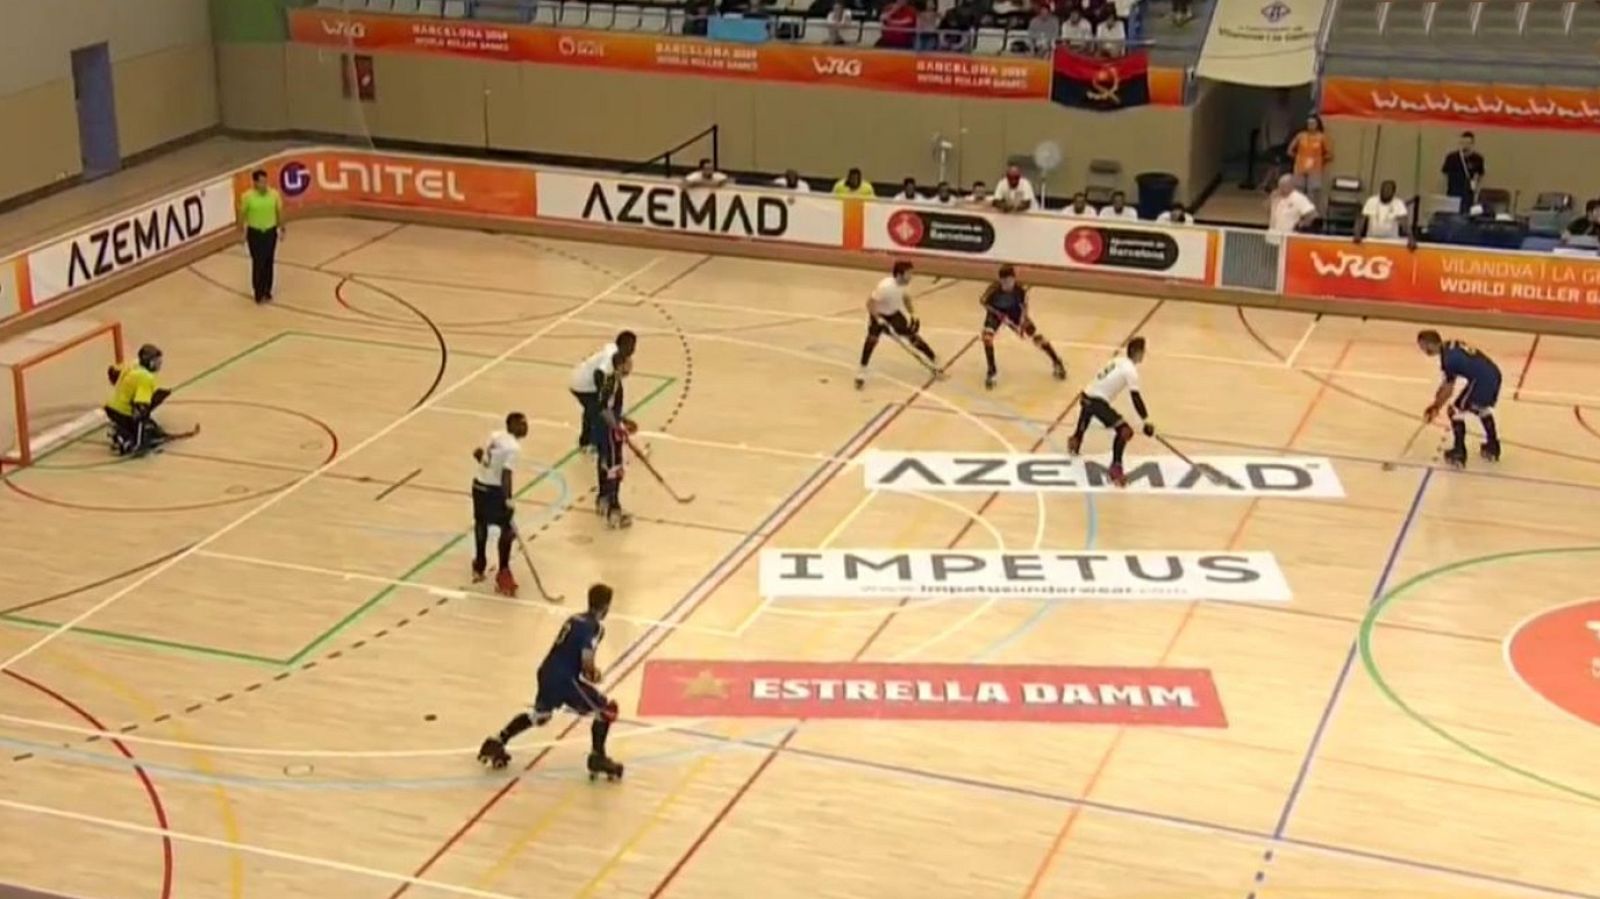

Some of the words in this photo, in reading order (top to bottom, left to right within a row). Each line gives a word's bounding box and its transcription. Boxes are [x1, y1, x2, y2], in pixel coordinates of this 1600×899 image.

[916, 60, 997, 76] BARCELONA
[316, 160, 466, 201] UNITEL
[581, 181, 789, 236] AZEMAD
[67, 194, 205, 287] AZEMAD
[929, 229, 983, 244] Barcelona
[1109, 246, 1165, 260] Barcelona
[1310, 250, 1394, 281] WRG
[1441, 256, 1533, 279] VILANOVA
[1552, 266, 1576, 283] LA
[1440, 276, 1505, 297] WORLD
[1511, 283, 1580, 304] ROLLER
[878, 457, 1315, 491] AZEMAD
[779, 552, 1262, 584] IMPETUS
[751, 677, 1011, 705] ESTRELLA
[1020, 682, 1198, 708] DAMM
